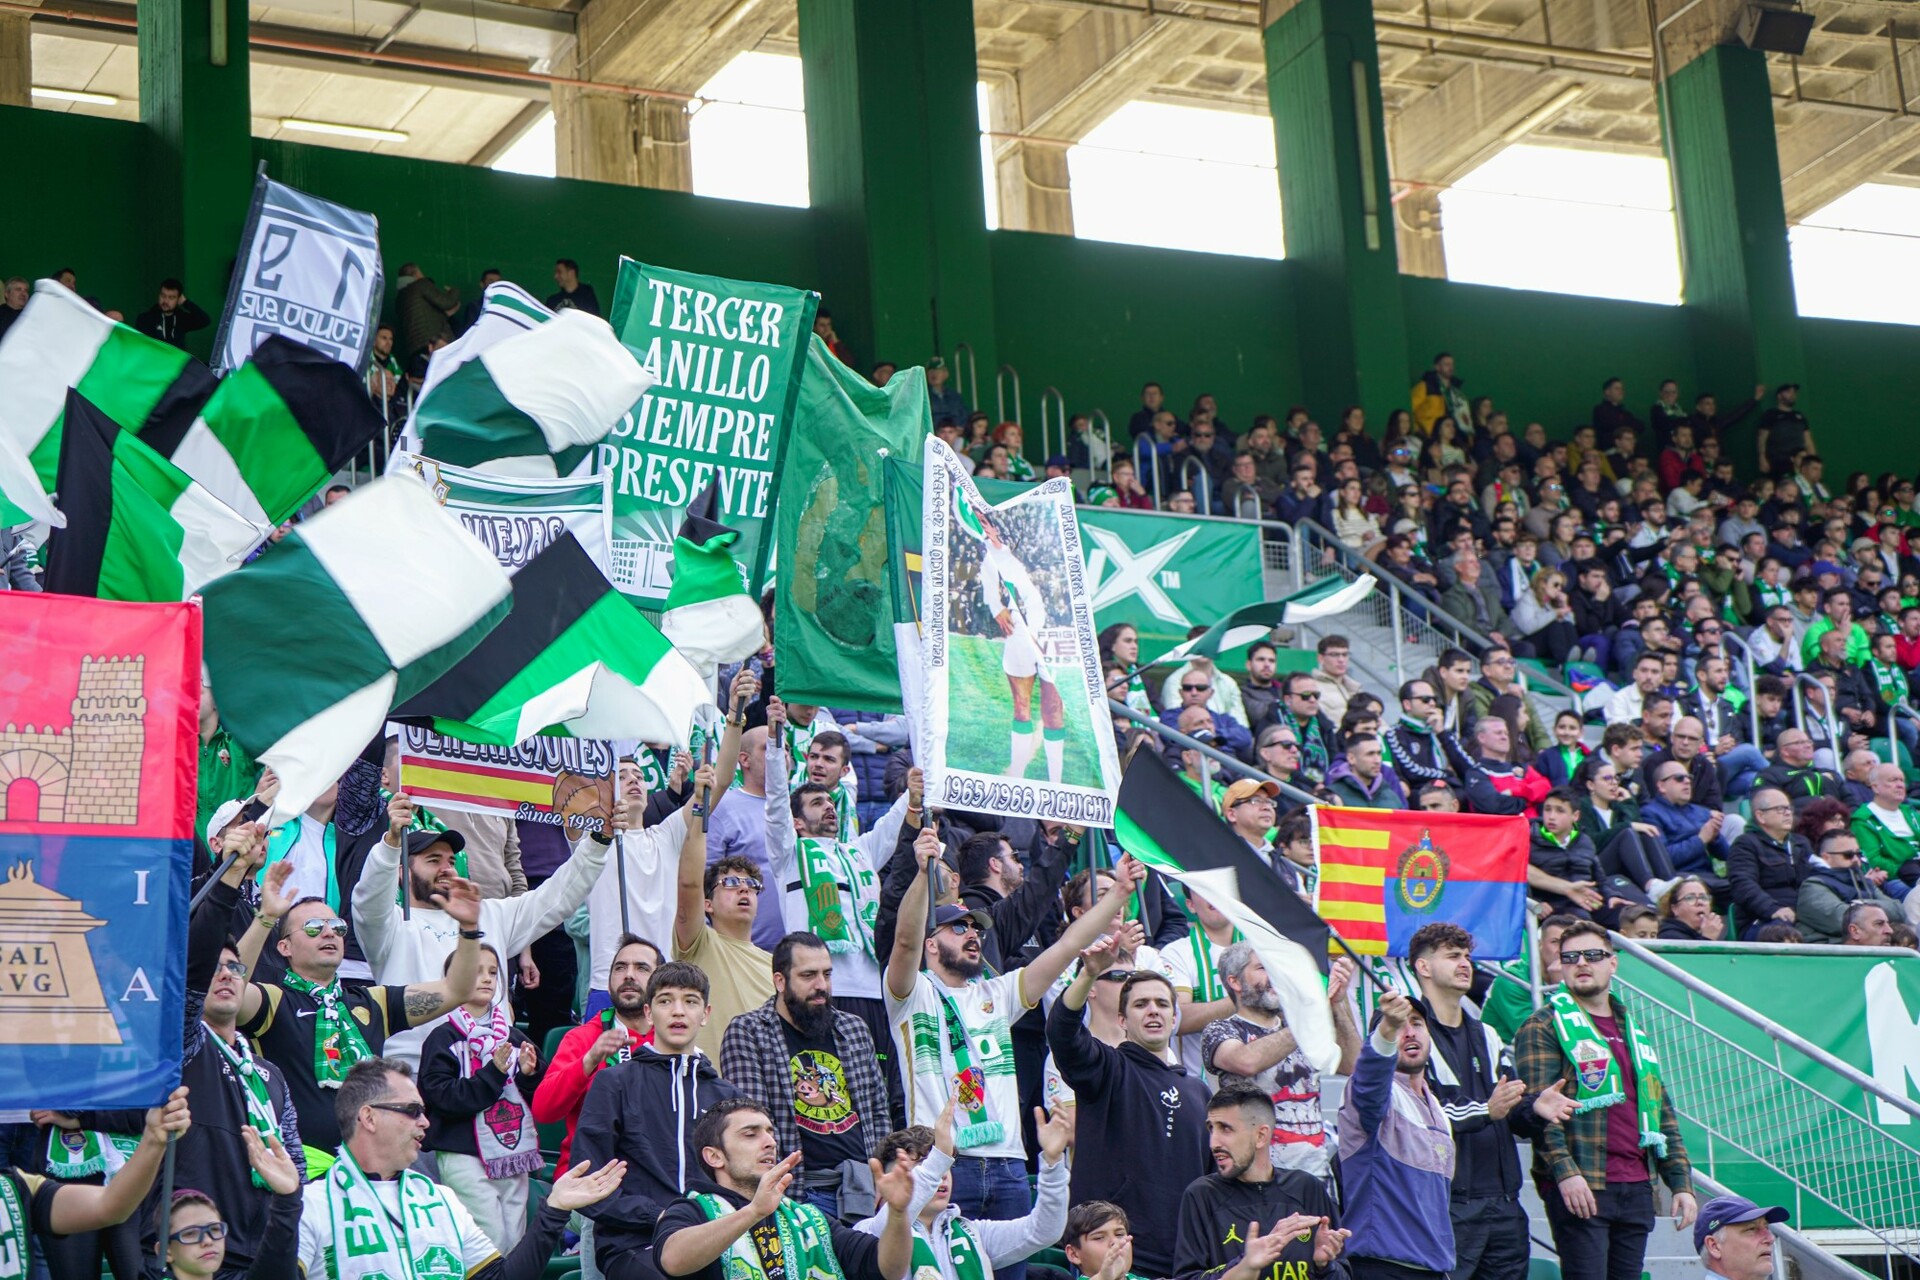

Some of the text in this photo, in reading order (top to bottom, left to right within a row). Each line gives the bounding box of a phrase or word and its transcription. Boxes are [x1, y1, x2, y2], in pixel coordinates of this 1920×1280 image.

[649, 278, 784, 348] TERCER
[642, 336, 770, 403] ANILLO
[611, 394, 775, 462] SIEMPRE
[597, 443, 773, 518] PRESENTE
[932, 530, 945, 546] EL
[929, 550, 945, 588] NACIÓ
[932, 590, 945, 668] DELANTERO.
[515, 802, 605, 834] Since 1923
[943, 775, 1112, 824] 1965/1966 PICHICHI
[133, 870, 150, 905] I
[0, 945, 48, 965] AL
[119, 966, 159, 1001] A
